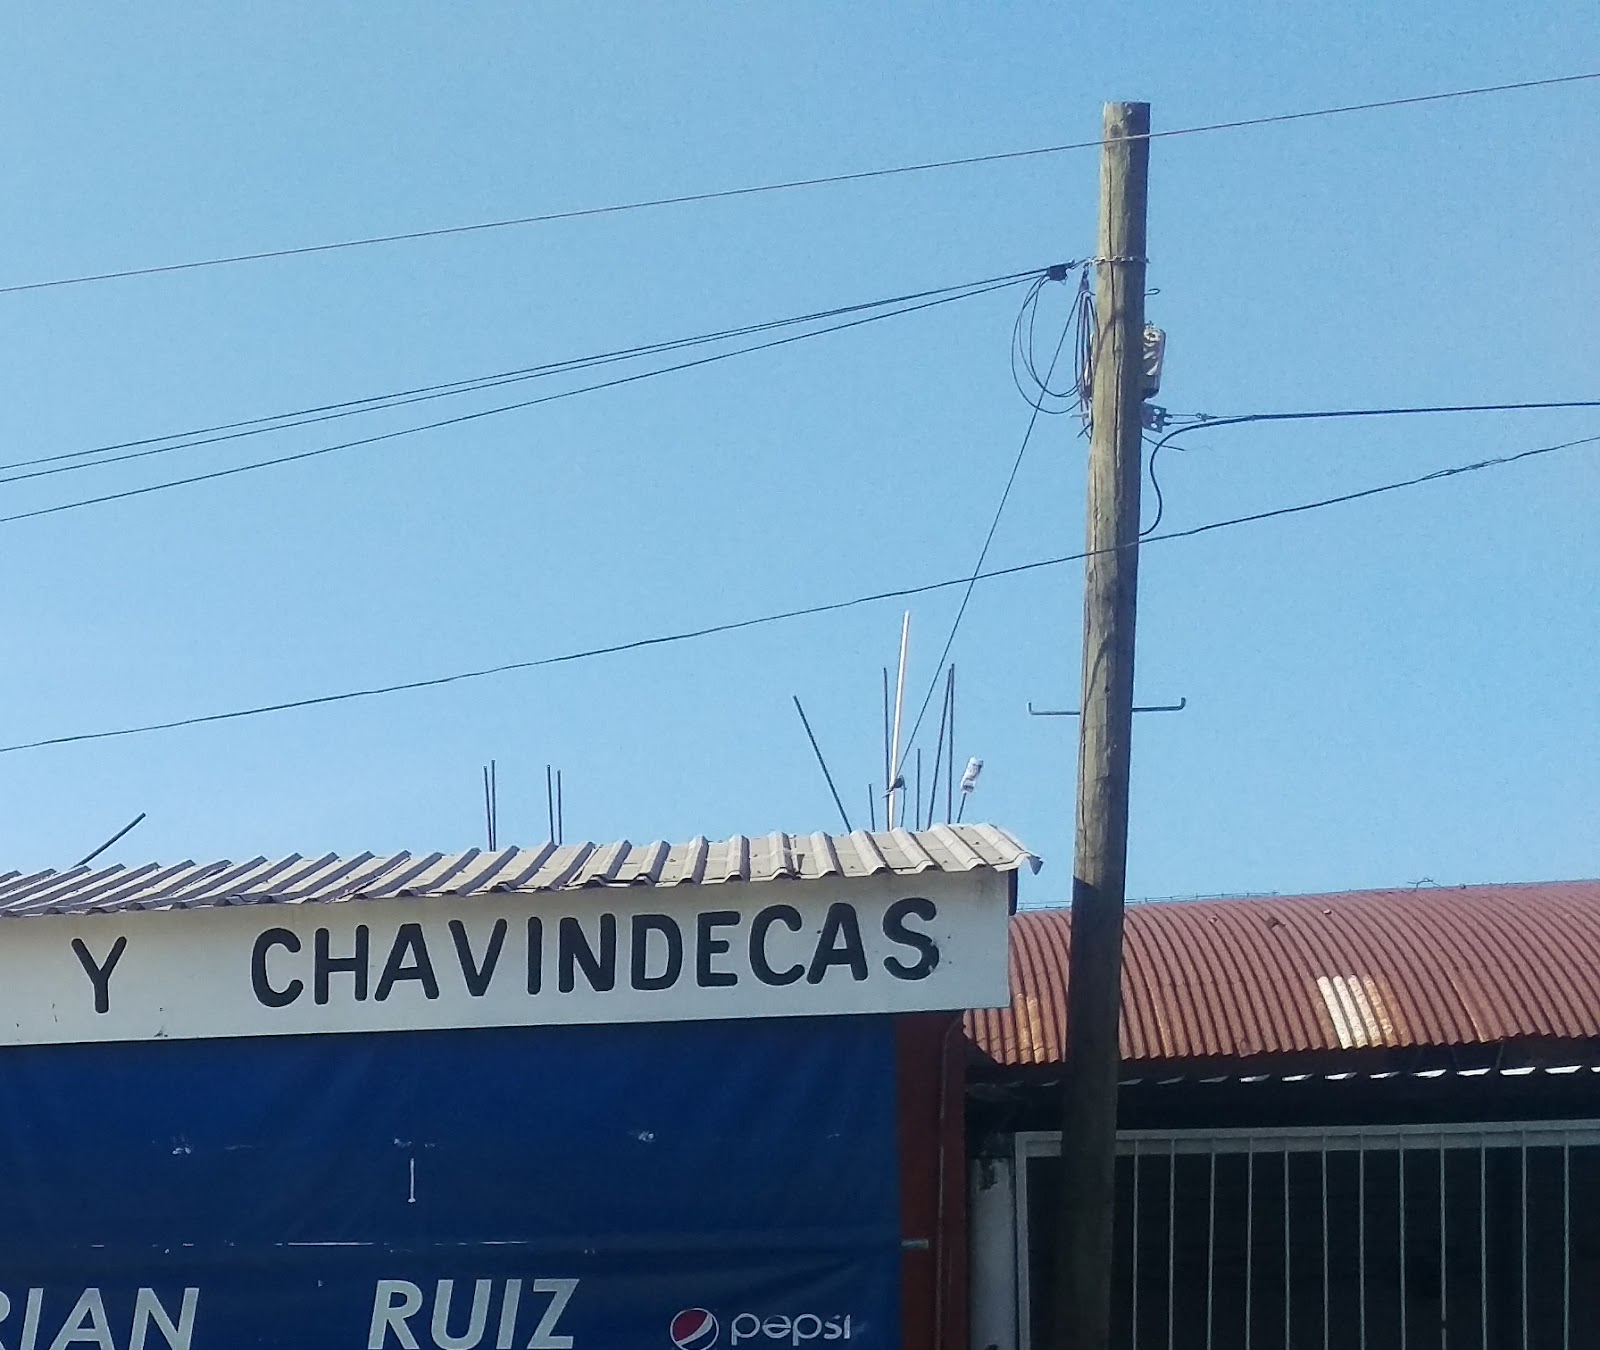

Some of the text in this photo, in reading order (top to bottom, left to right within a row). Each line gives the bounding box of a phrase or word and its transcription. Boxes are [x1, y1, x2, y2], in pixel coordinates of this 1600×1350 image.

[71, 936, 127, 1013] Y
[252, 897, 940, 1008] CHAVINDECAS
[730, 1312, 851, 1347] pepsi
